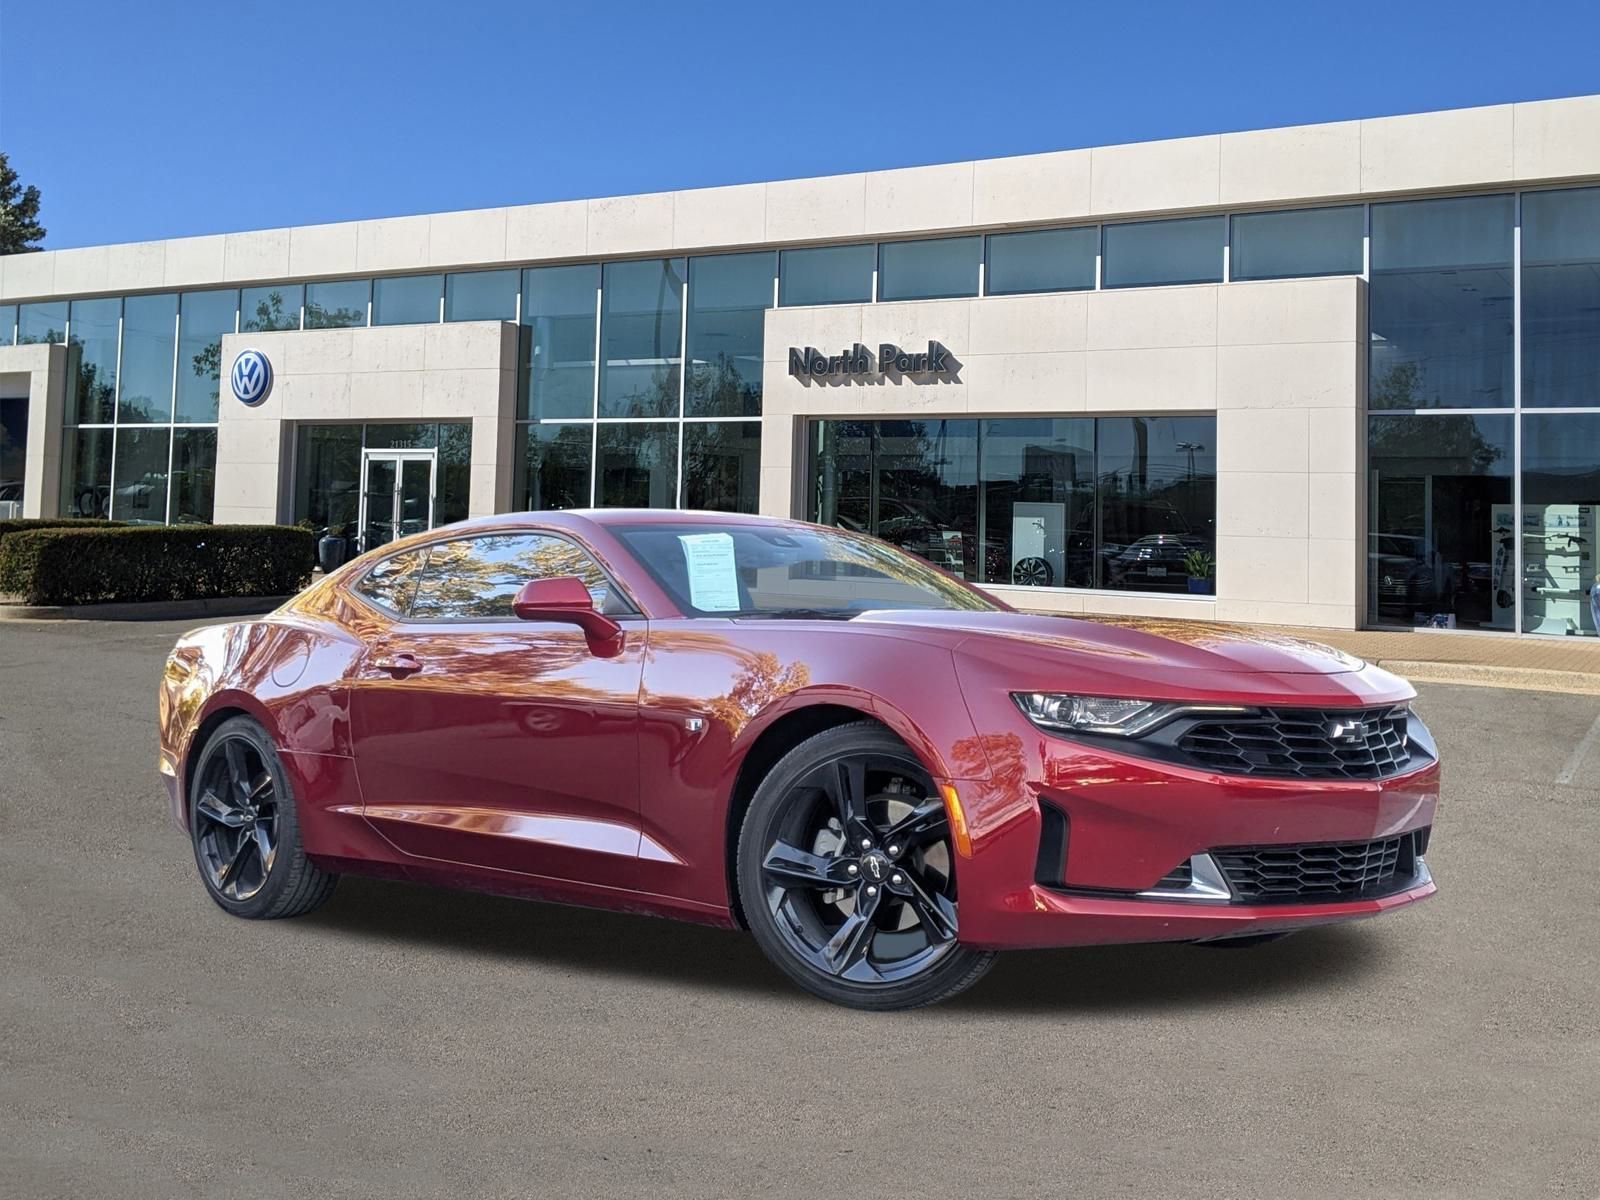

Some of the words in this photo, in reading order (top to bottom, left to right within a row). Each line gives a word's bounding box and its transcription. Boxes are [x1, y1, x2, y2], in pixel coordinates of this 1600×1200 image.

[232, 351, 269, 402] VW
[788, 343, 872, 376] North
[878, 340, 948, 374] Park
